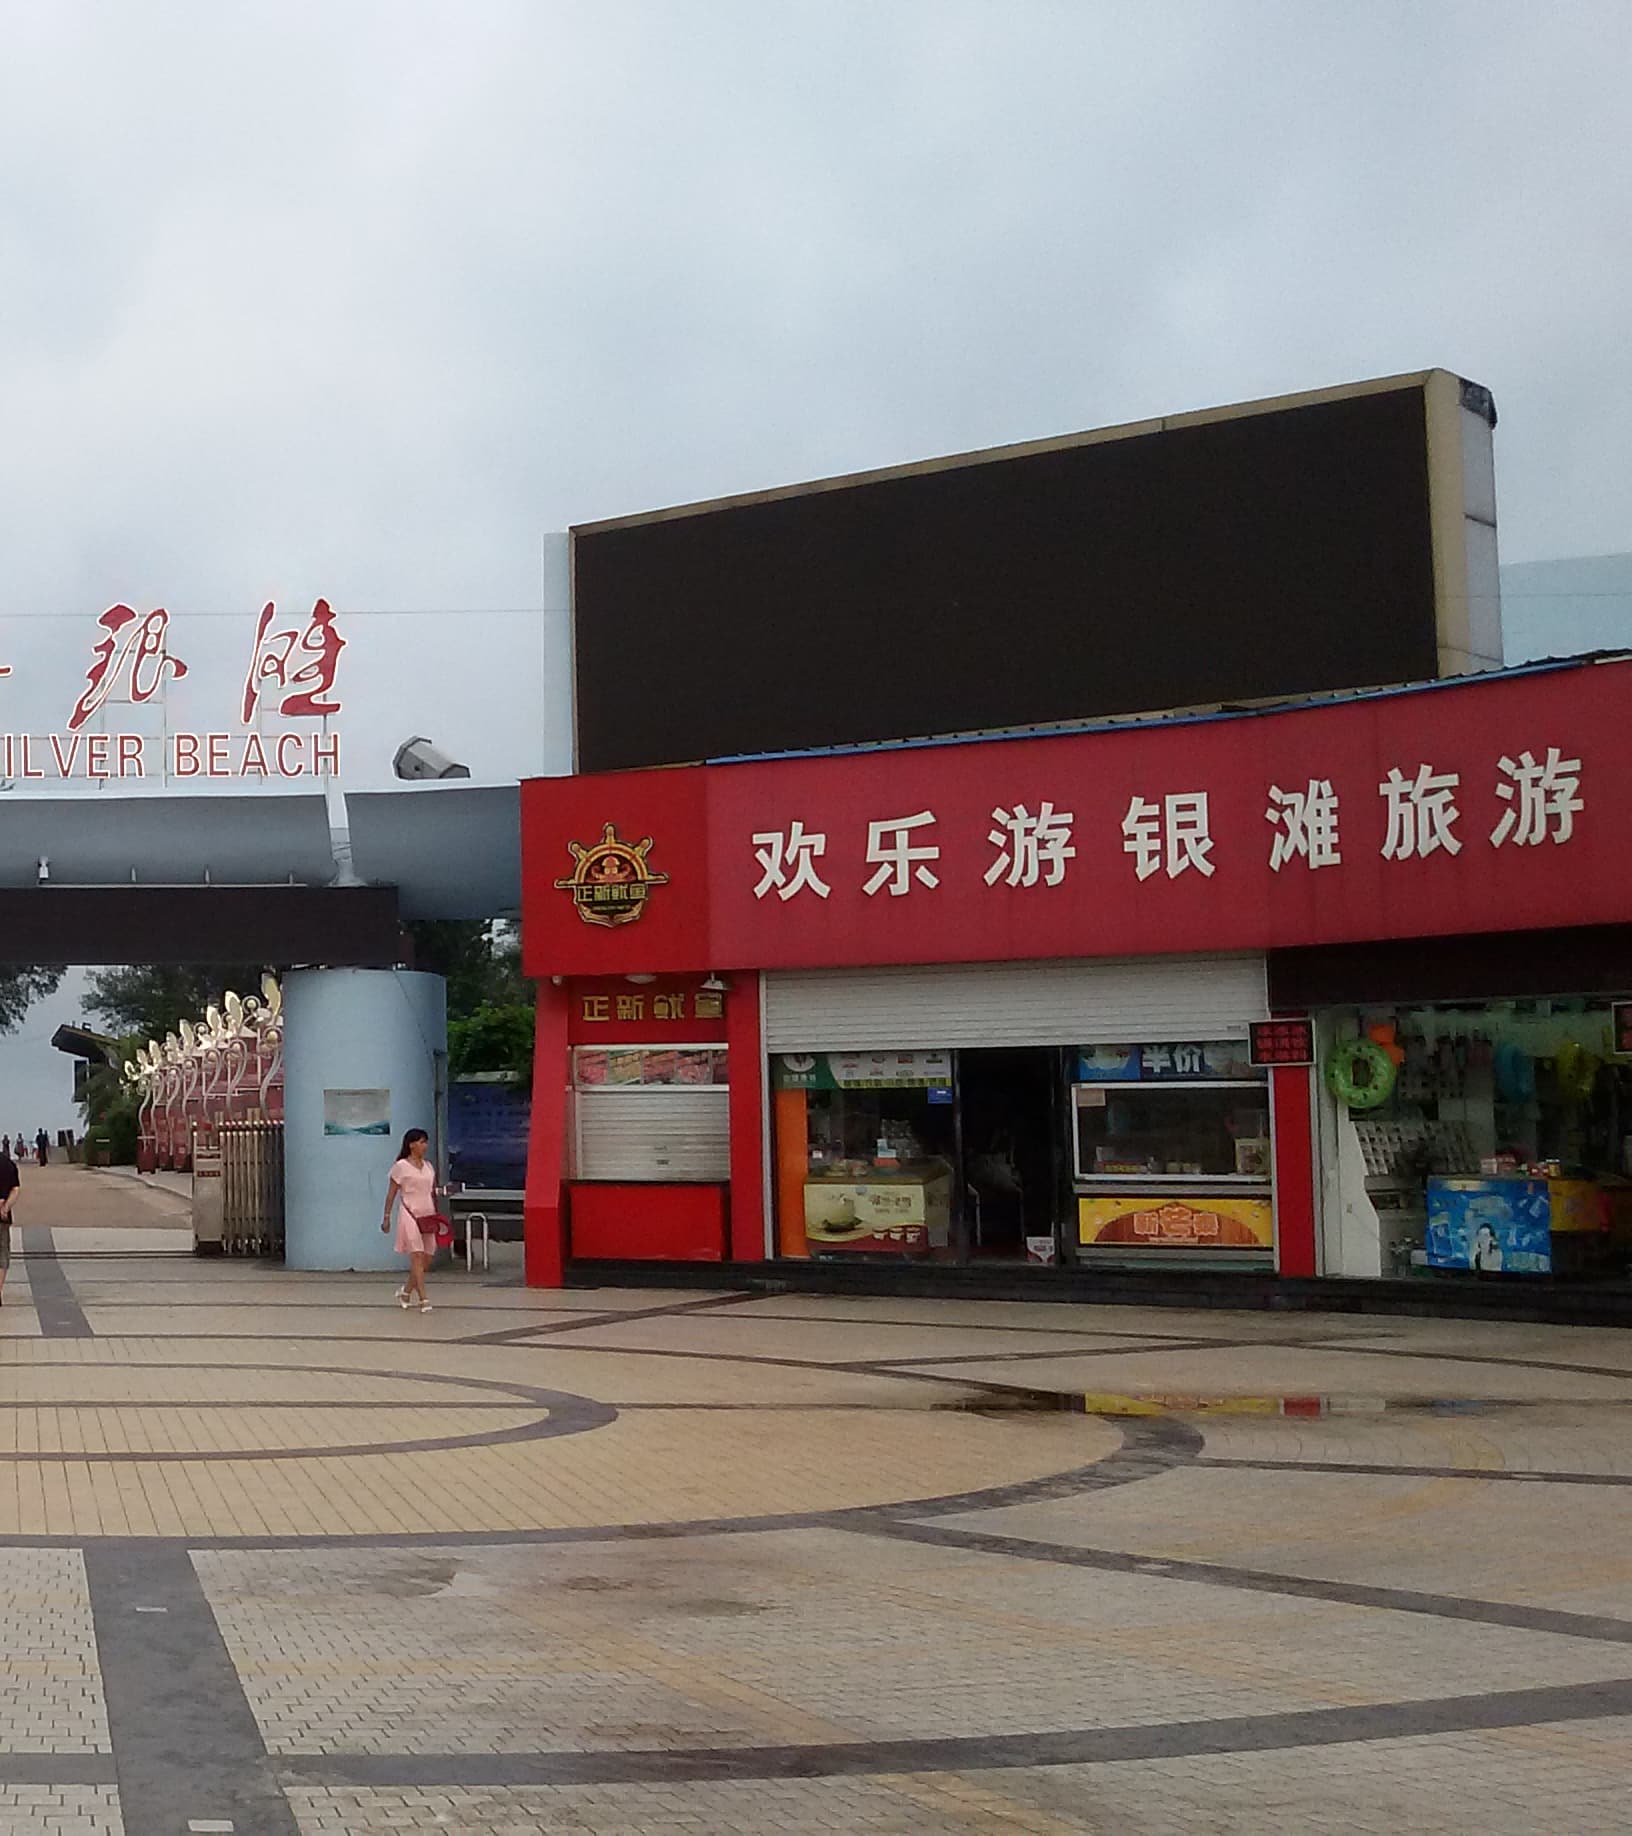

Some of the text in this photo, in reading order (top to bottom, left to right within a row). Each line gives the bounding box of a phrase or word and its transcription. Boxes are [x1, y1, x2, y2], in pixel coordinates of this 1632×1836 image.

[173, 732, 340, 779] BEACH
[751, 746, 1584, 902] 欢乐游银滩旅游
